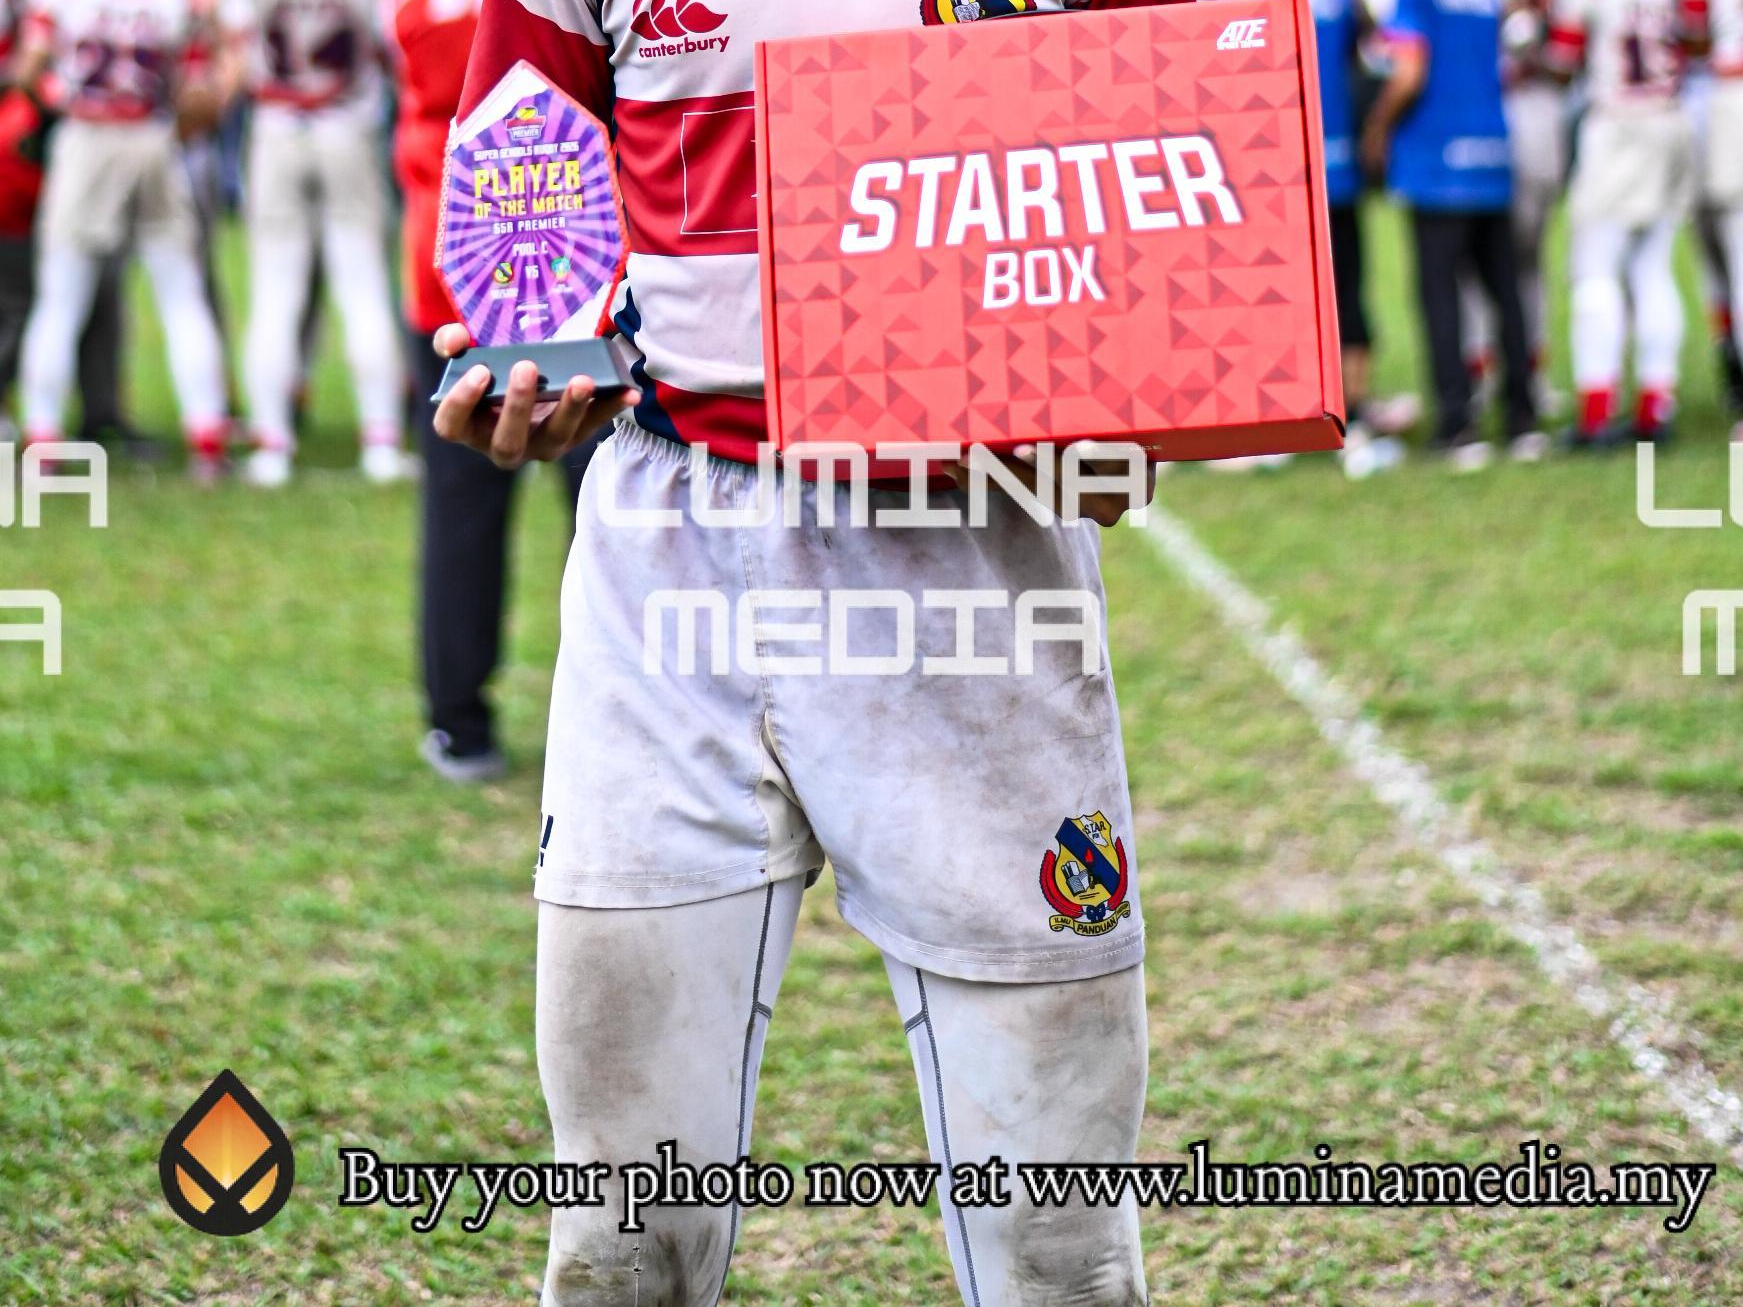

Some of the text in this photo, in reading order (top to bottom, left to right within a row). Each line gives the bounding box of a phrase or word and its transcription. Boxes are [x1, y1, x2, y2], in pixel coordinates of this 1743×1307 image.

[638, 35, 731, 58] canterbury
[474, 149, 498, 161] SUPER
[474, 160, 581, 199] PLAYER
[840, 134, 1244, 253] STARTER
[474, 193, 583, 219] OF THE MATCH
[517, 216, 567, 232] PREMIER
[512, 240, 549, 257] POOL C
[525, 265, 539, 279] VS
[983, 245, 1106, 309] BOX
[1054, 916, 1117, 932] ILMU PANDUAN
